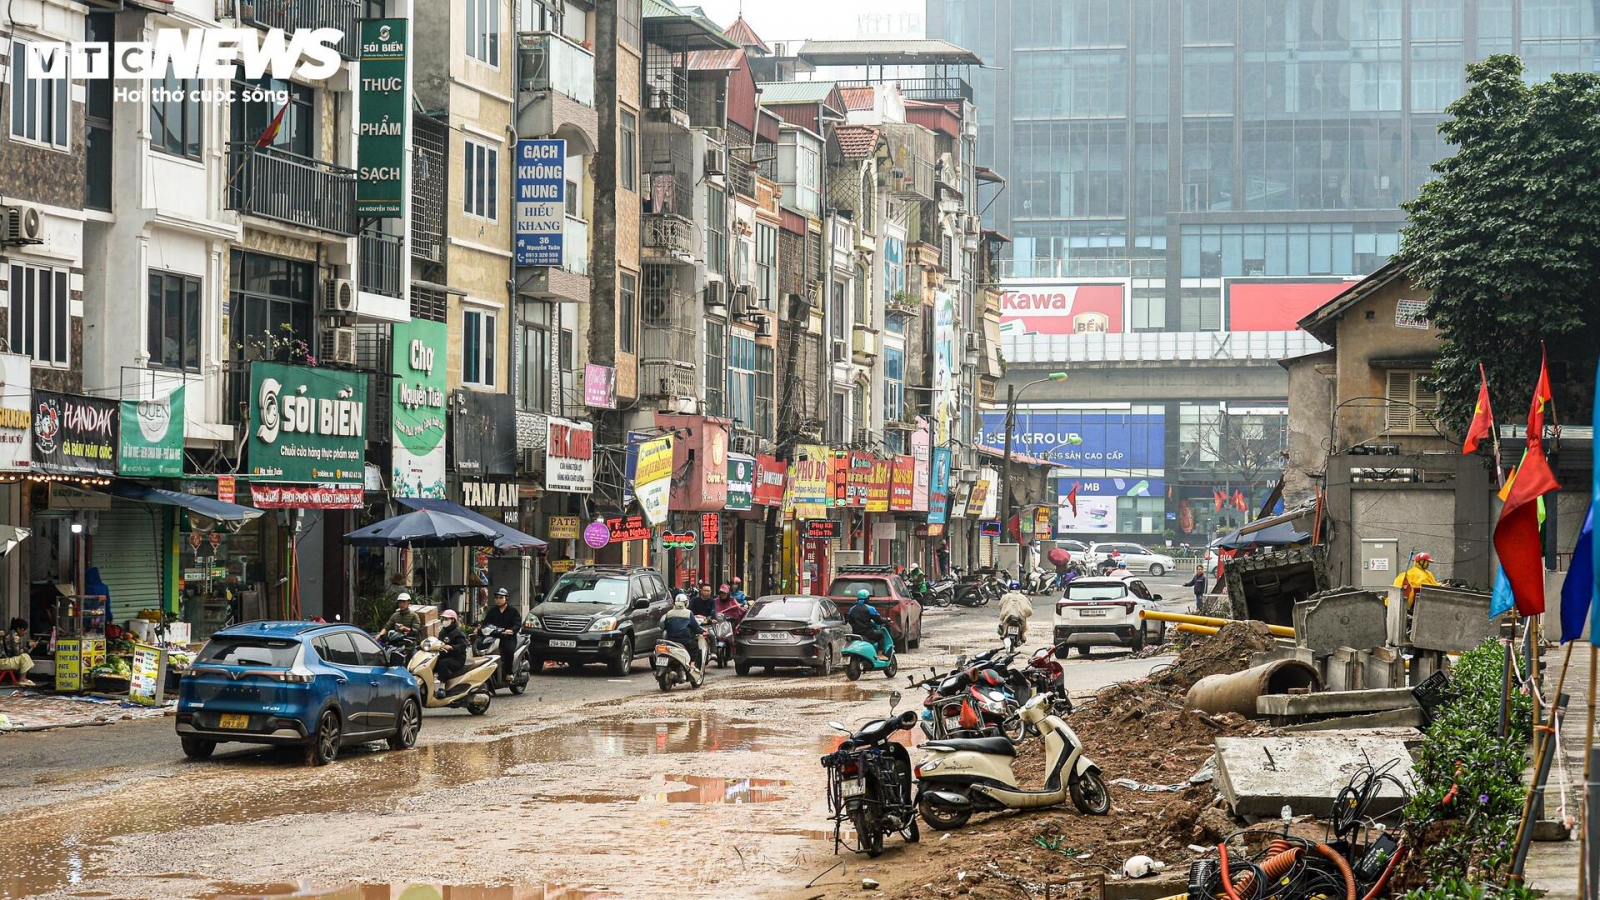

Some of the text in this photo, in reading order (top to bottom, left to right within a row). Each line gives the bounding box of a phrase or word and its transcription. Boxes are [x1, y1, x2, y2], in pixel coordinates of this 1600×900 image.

[363, 41, 403, 52] SÓI BIỂN
[362, 77, 402, 95] THỰC
[360, 114, 401, 136] PHẨM
[523, 144, 559, 162] GẠCH
[360, 167, 400, 184] SẠCH
[518, 163, 562, 179] KHÔNG
[521, 184, 558, 199] NUNG
[524, 203, 554, 217] HIẾU
[518, 221, 560, 231] KHANG
[1000, 290, 1066, 310] kawa
[409, 339, 435, 376] Chợ
[281, 385, 316, 434] SÓI
[318, 387, 364, 437] BIỂN
[280, 444, 296, 456] Chuỗi
[307, 446, 320, 460] hàng
[1084, 452, 1102, 460] CAO
[1106, 450, 1124, 460] CẤP
[497, 483, 519, 507] AN
[1084, 482, 1100, 492] MB
[504, 511, 518, 523] HAIR
[550, 518, 577, 526] PATE
[806, 541, 817, 549] GIÁ
